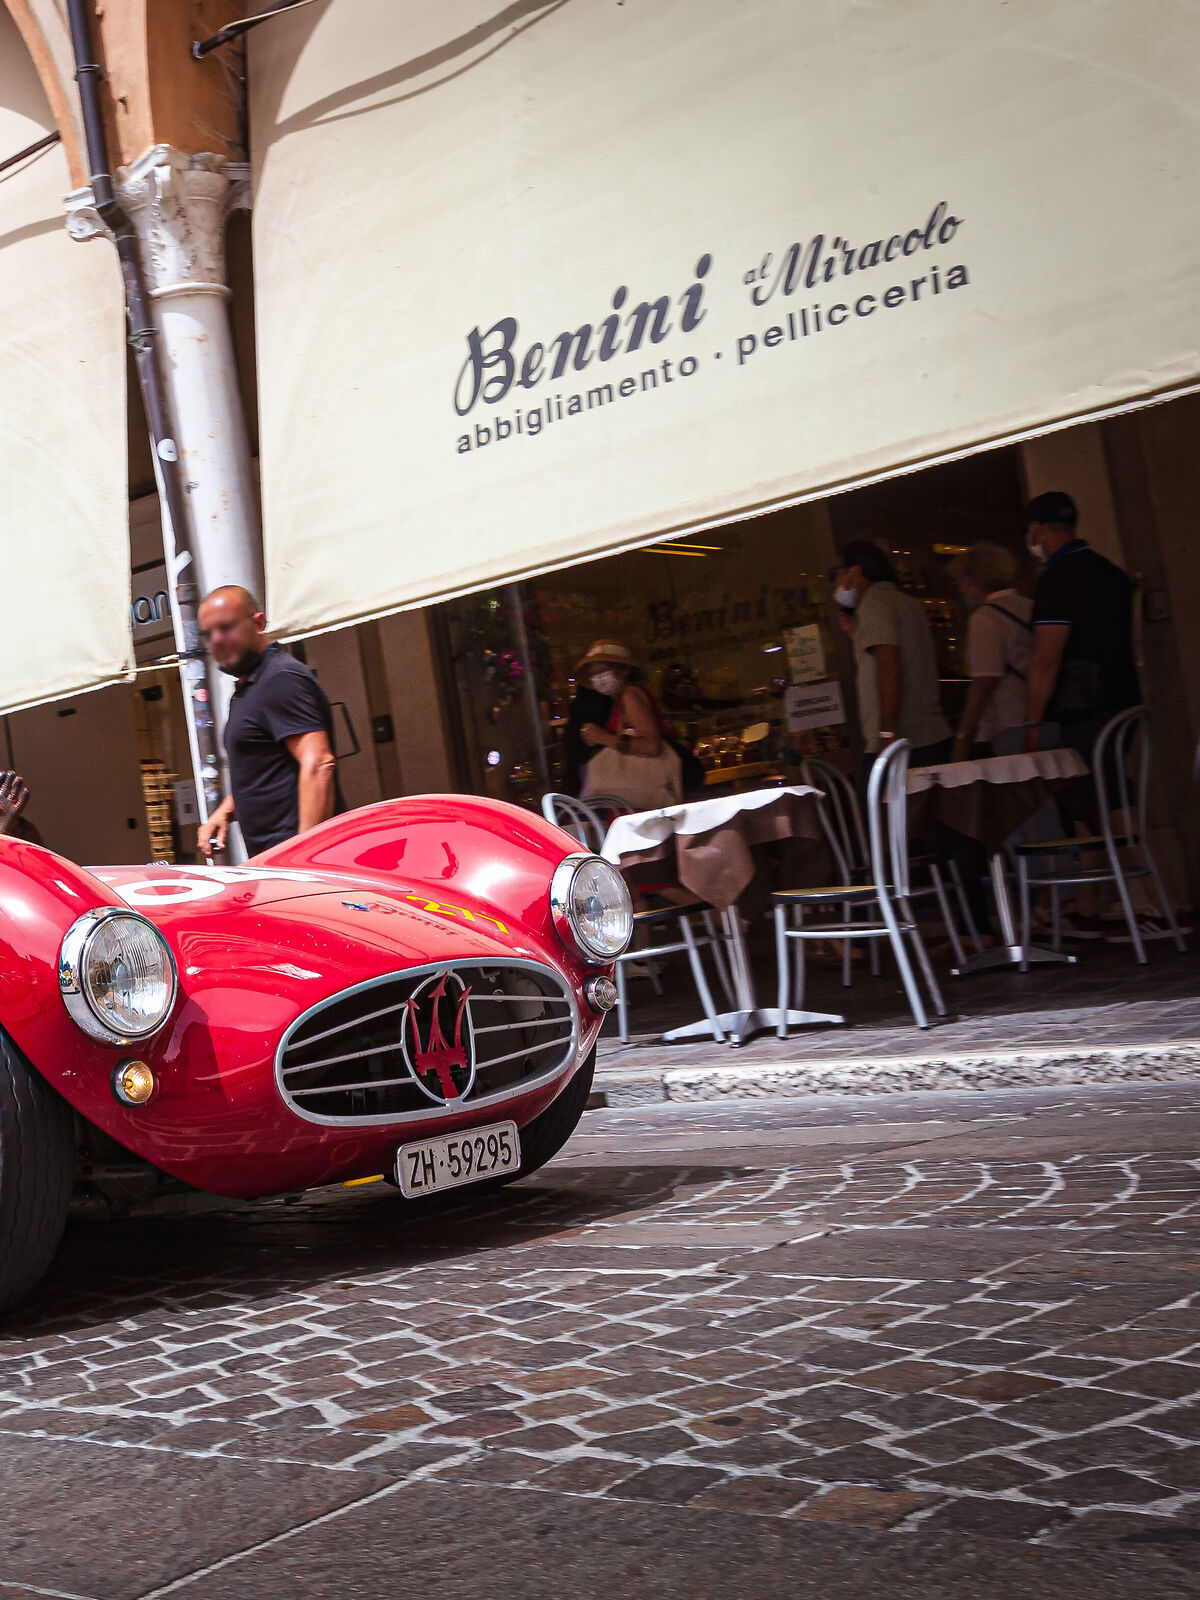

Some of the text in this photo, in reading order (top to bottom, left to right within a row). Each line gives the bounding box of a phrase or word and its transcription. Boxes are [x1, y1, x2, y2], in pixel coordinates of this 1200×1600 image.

[454, 200, 966, 417] Benini al Miracolo
[456, 265, 970, 454] abbigliamento pellicceria
[405, 895, 509, 935] 277
